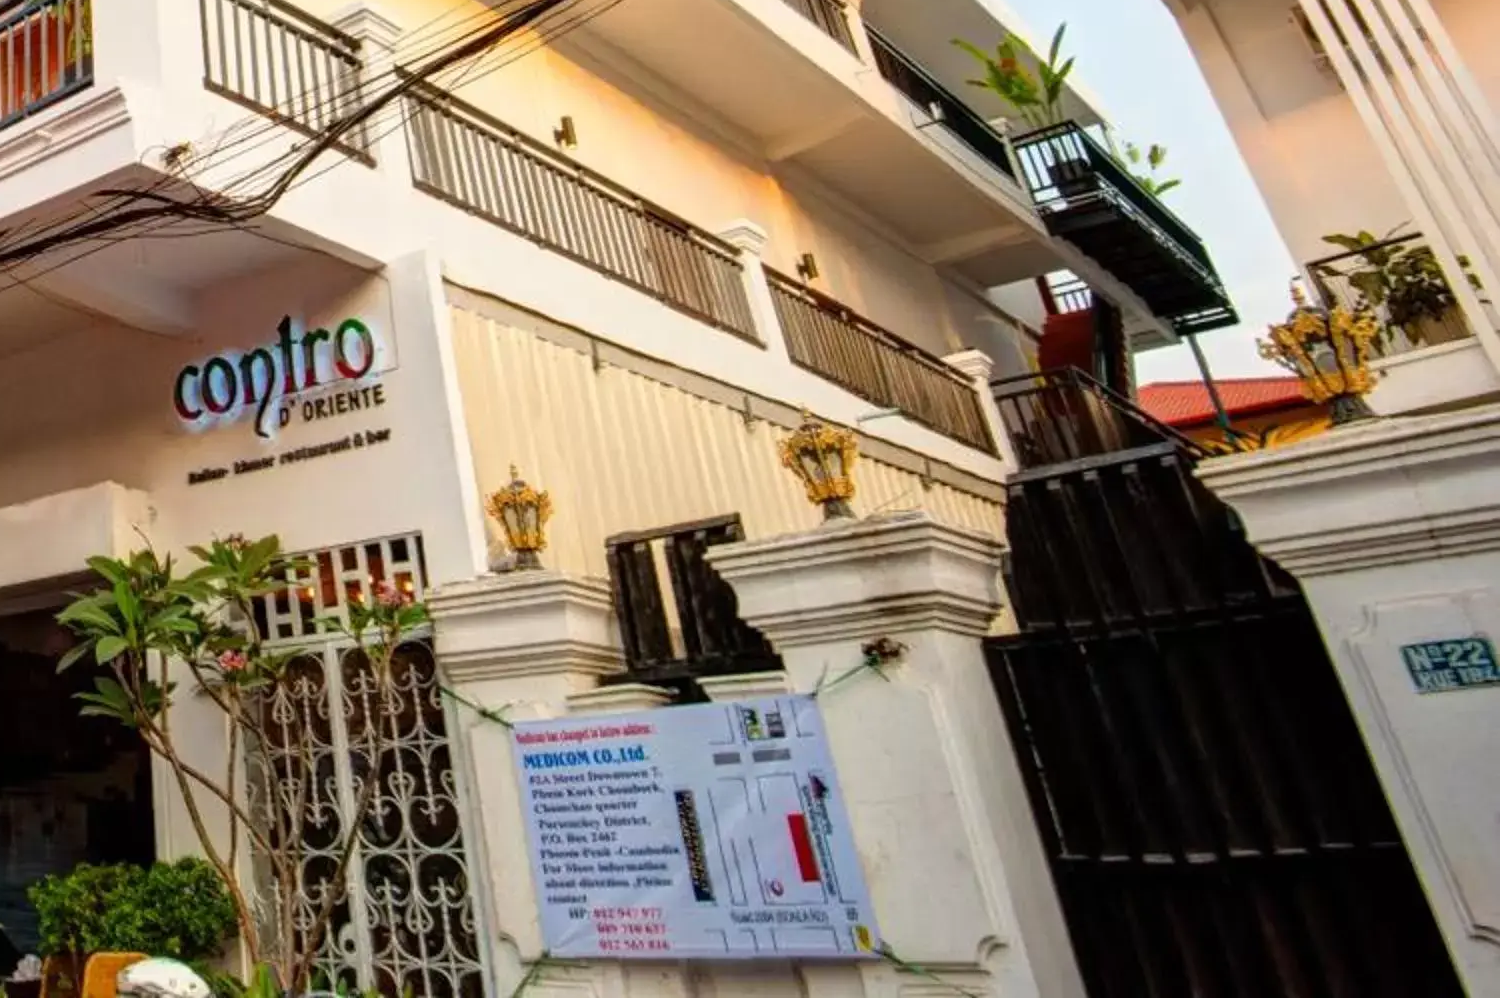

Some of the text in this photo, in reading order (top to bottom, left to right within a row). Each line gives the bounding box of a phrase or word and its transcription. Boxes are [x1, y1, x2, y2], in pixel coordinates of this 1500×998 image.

[173, 313, 374, 439] contro
[303, 383, 387, 423] ORIENTE
[279, 434, 351, 466] restaurant
[366, 428, 392, 445] bar
[523, 749, 591, 769] MEDICOM
[551, 773, 585, 784] Street
